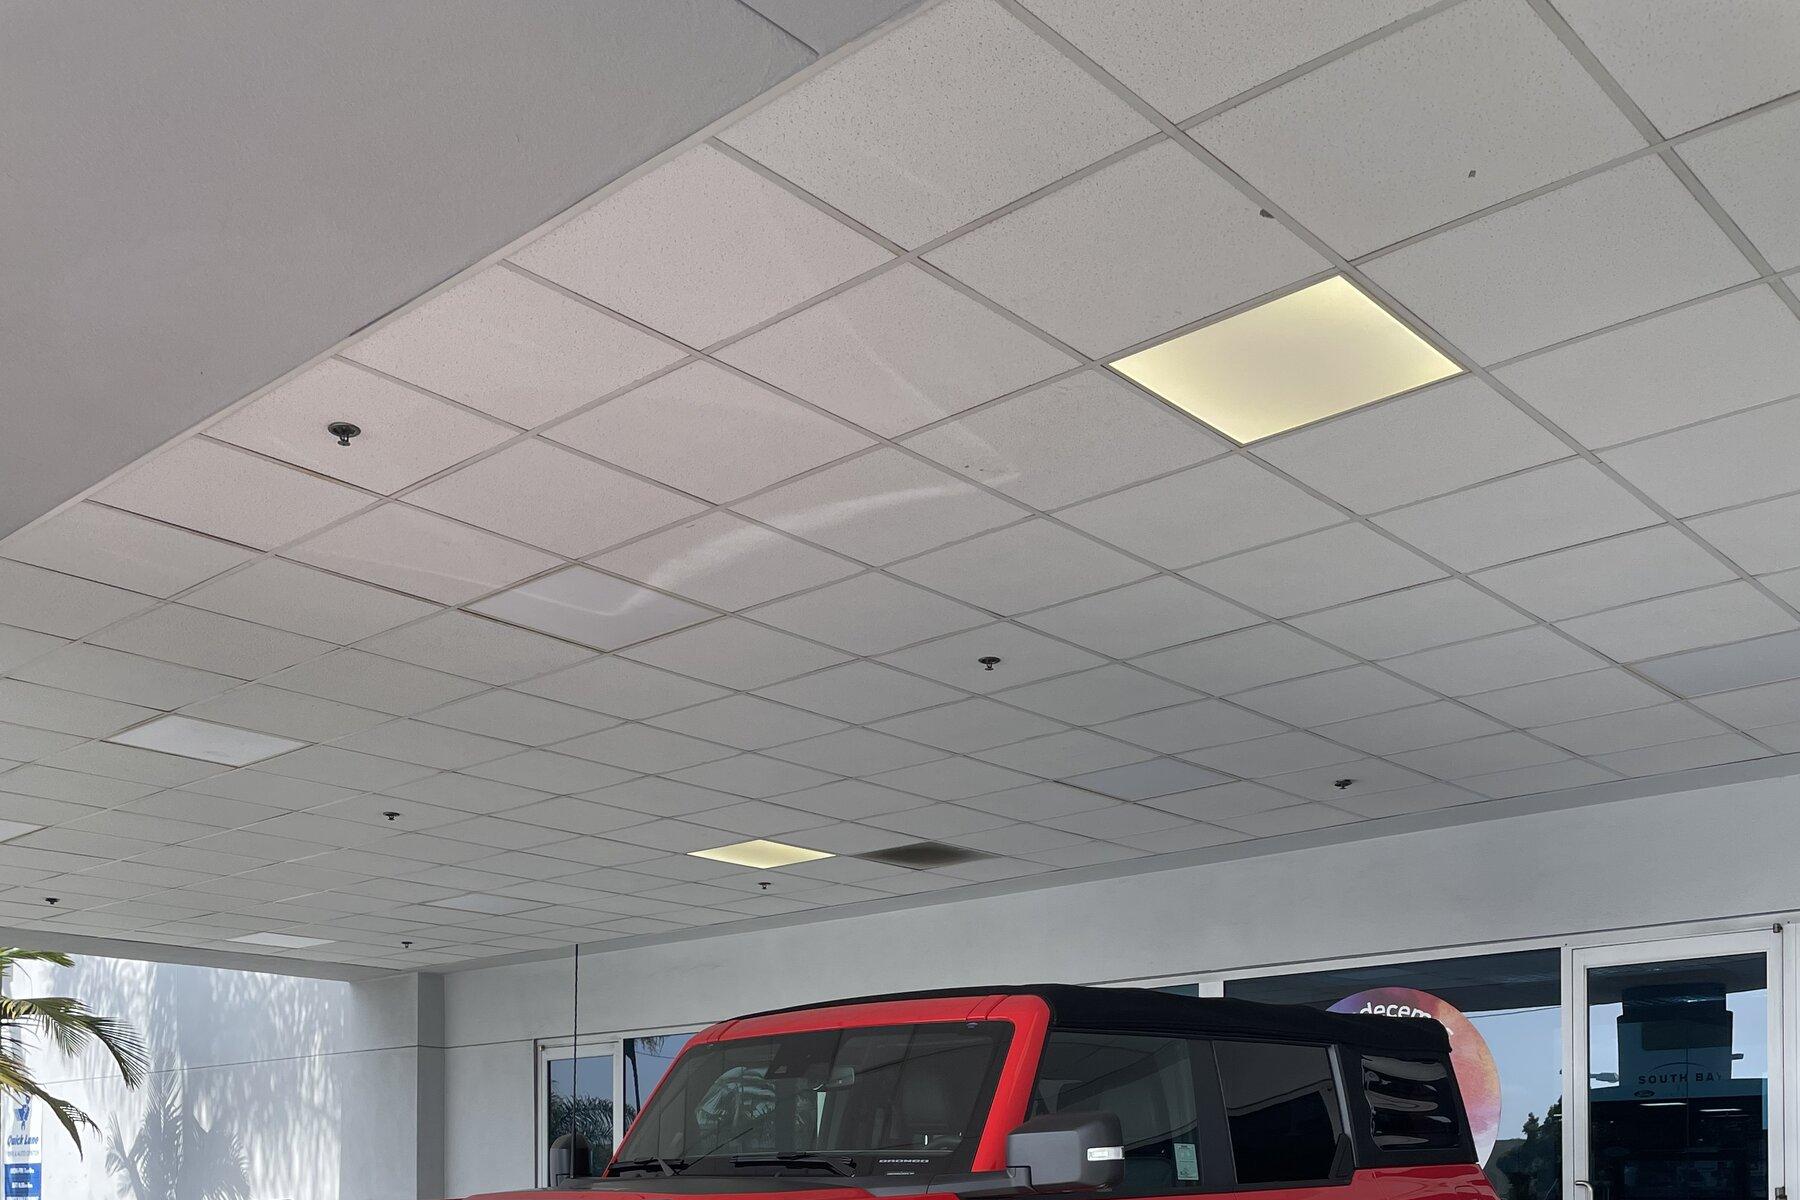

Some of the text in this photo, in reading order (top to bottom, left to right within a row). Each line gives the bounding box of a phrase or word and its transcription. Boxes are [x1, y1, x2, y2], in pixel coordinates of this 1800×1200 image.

[1638, 1073, 1688, 1085] SOUTH
[7, 1134, 39, 1147] Quick Lane
